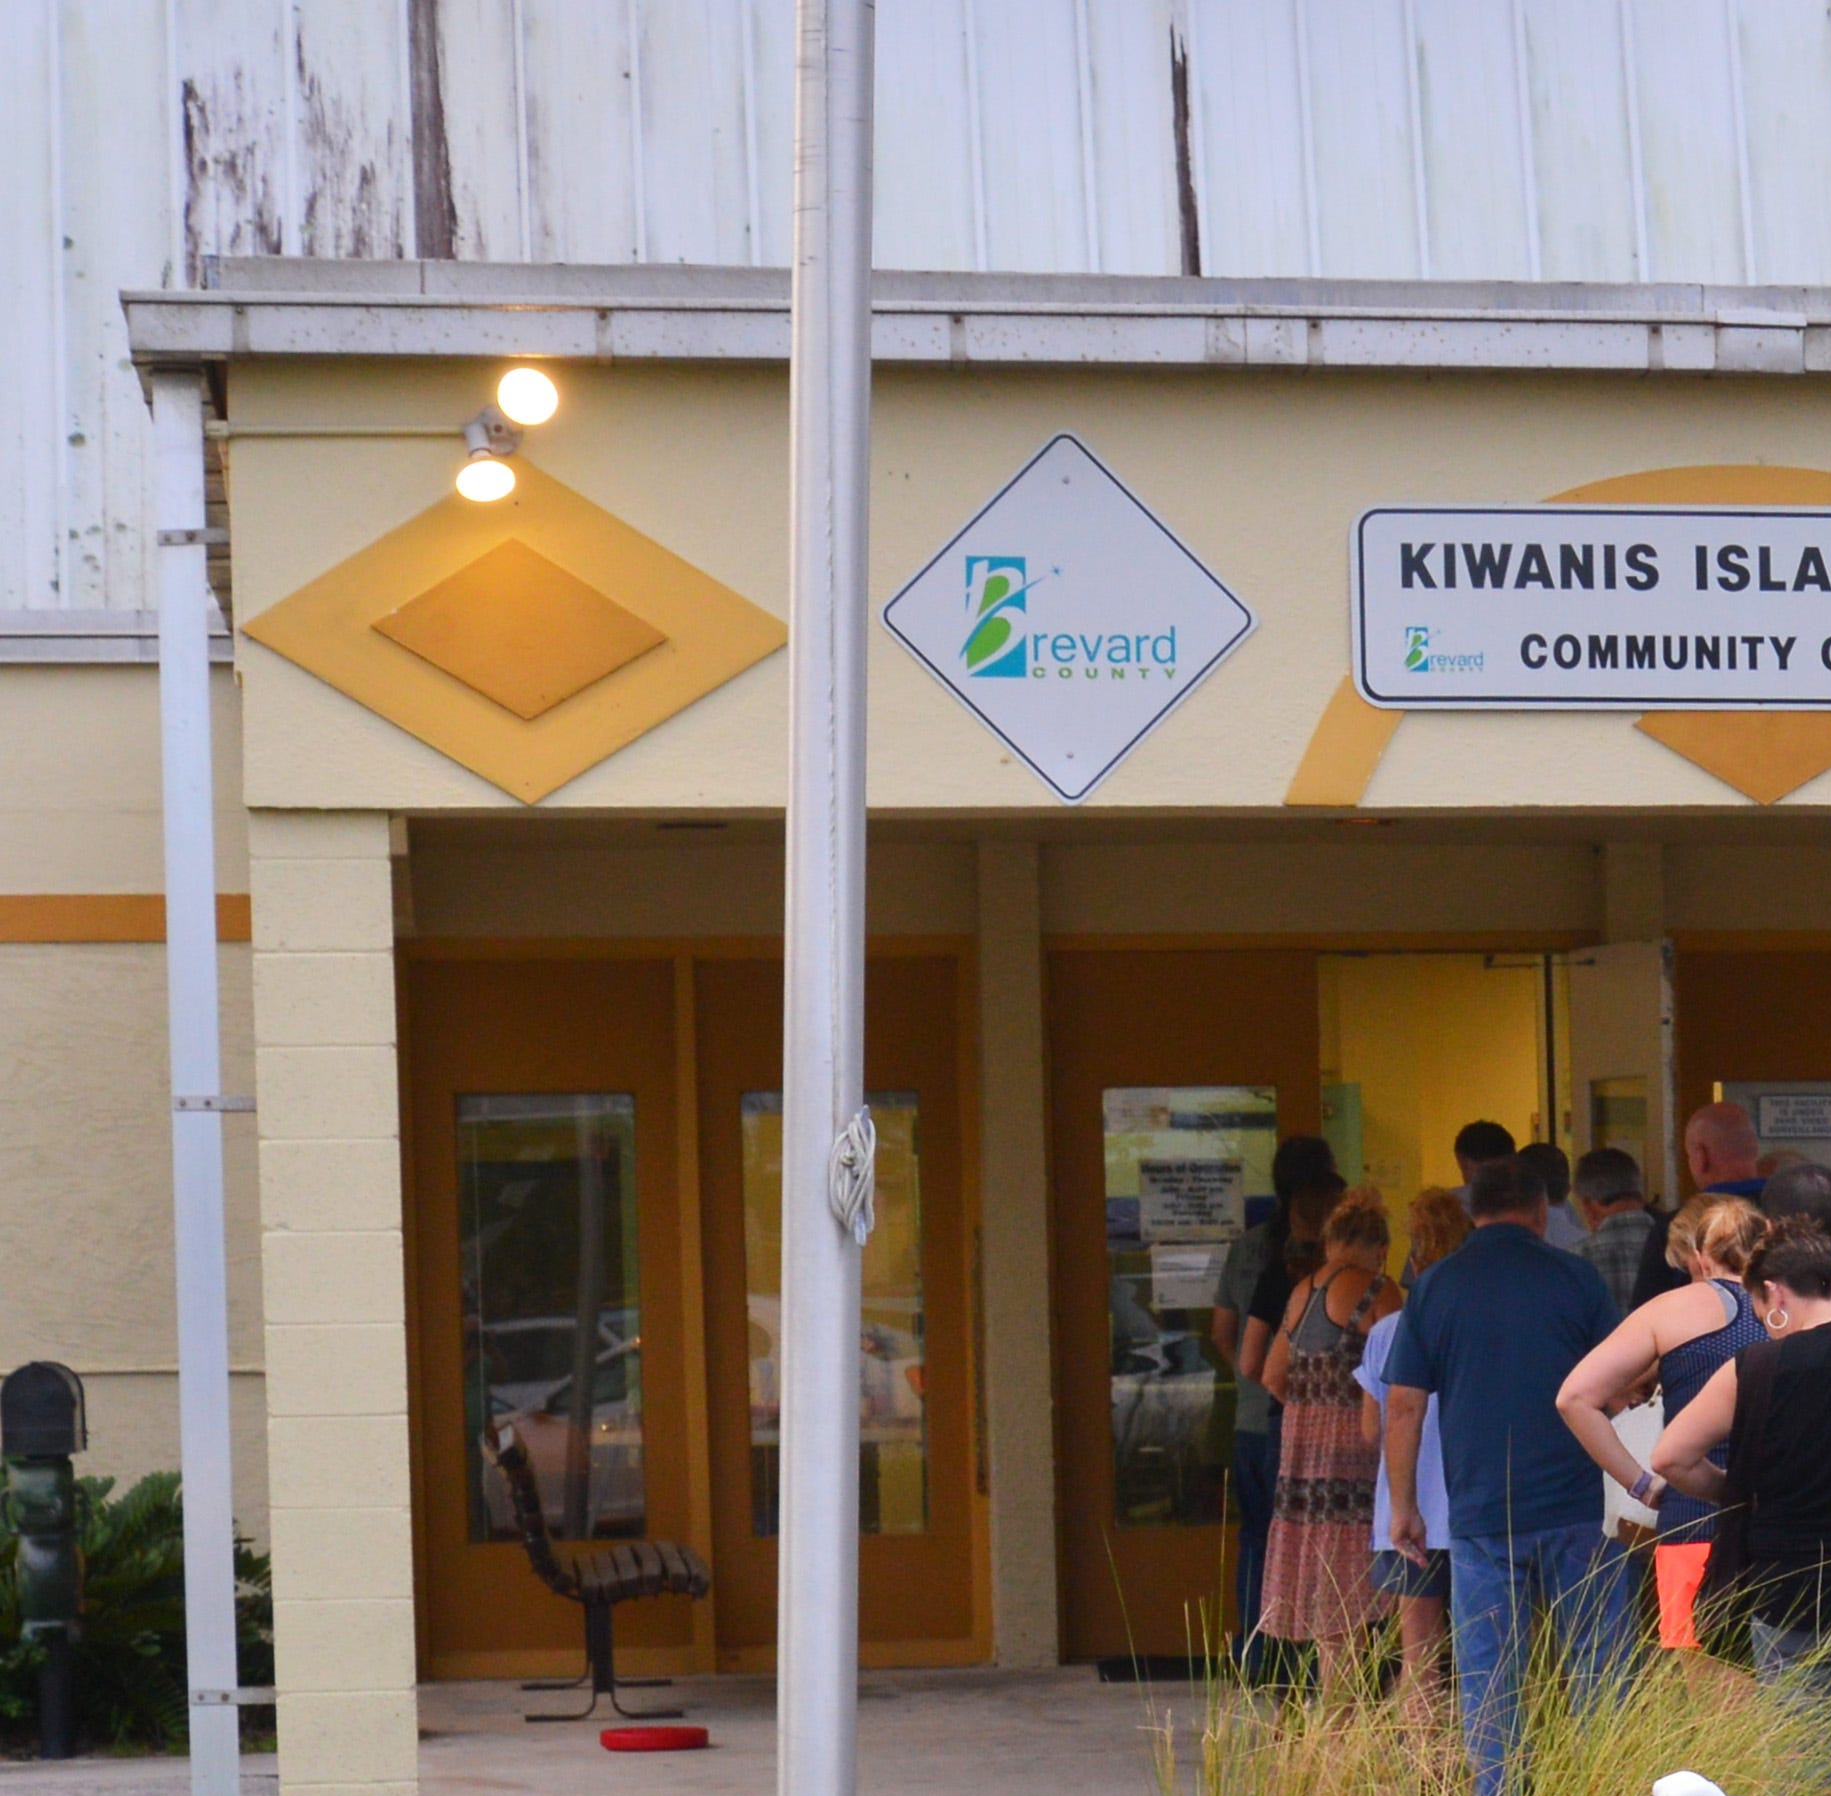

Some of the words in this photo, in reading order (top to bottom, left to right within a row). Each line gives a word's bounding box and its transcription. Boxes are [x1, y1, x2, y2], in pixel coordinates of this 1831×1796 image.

[1400, 543, 1660, 591] KIWANIS
[1520, 633, 1797, 671] COMMUNITY
[1032, 667, 1176, 679] COUNTY
